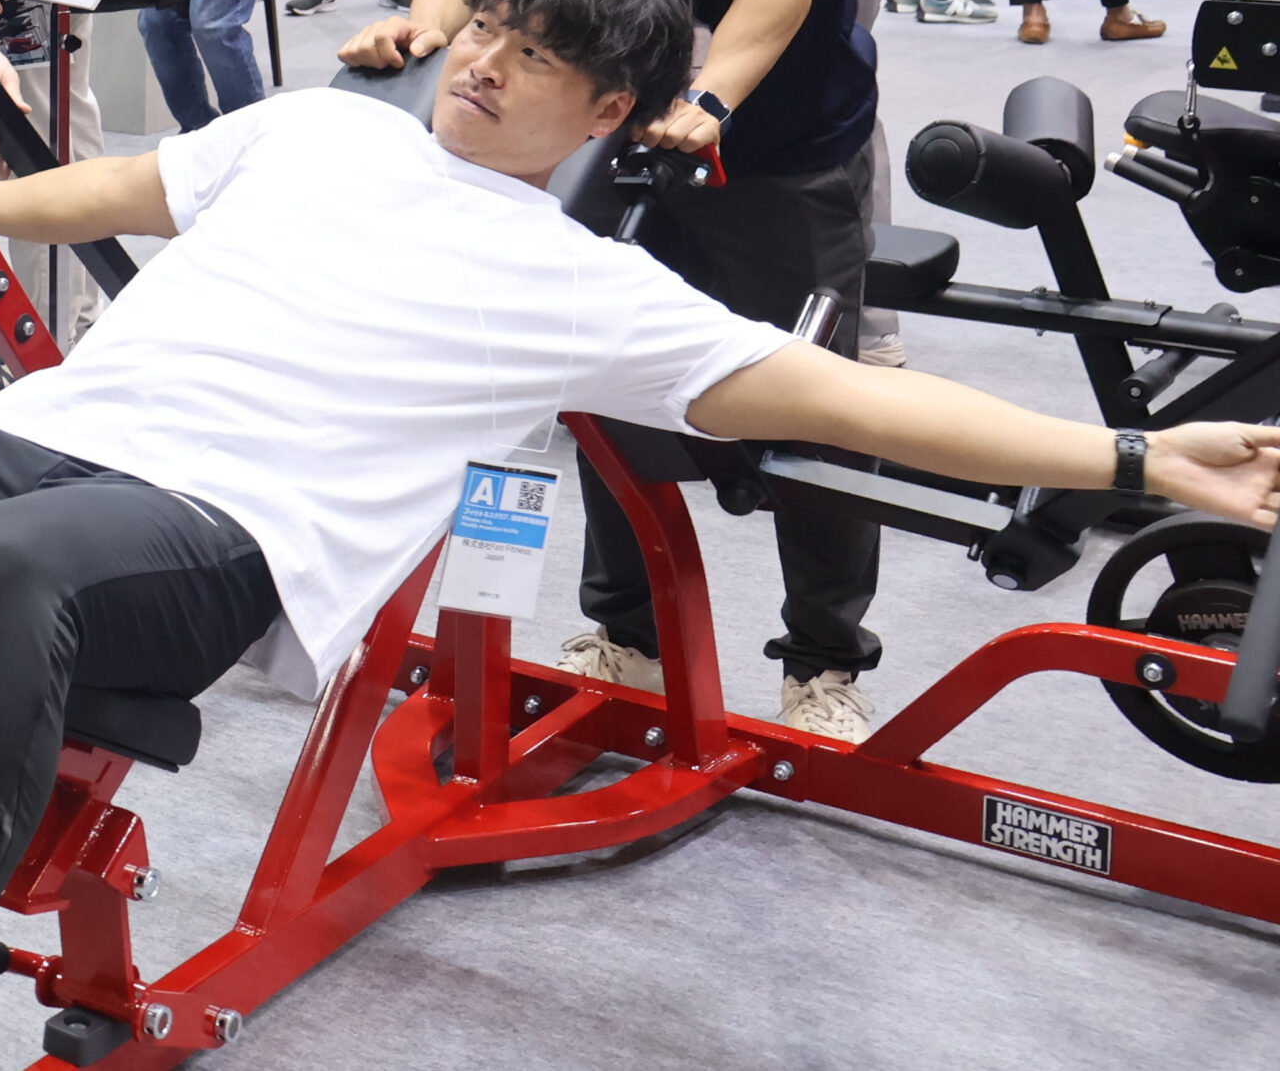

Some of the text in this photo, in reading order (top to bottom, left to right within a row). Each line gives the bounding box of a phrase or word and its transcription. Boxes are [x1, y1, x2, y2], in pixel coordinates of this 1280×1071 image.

[470, 476, 495, 506] A
[1176, 612, 1250, 632] HAMME
[996, 802, 1099, 847] HAMMER
[990, 823, 1102, 870] STRENGTH
